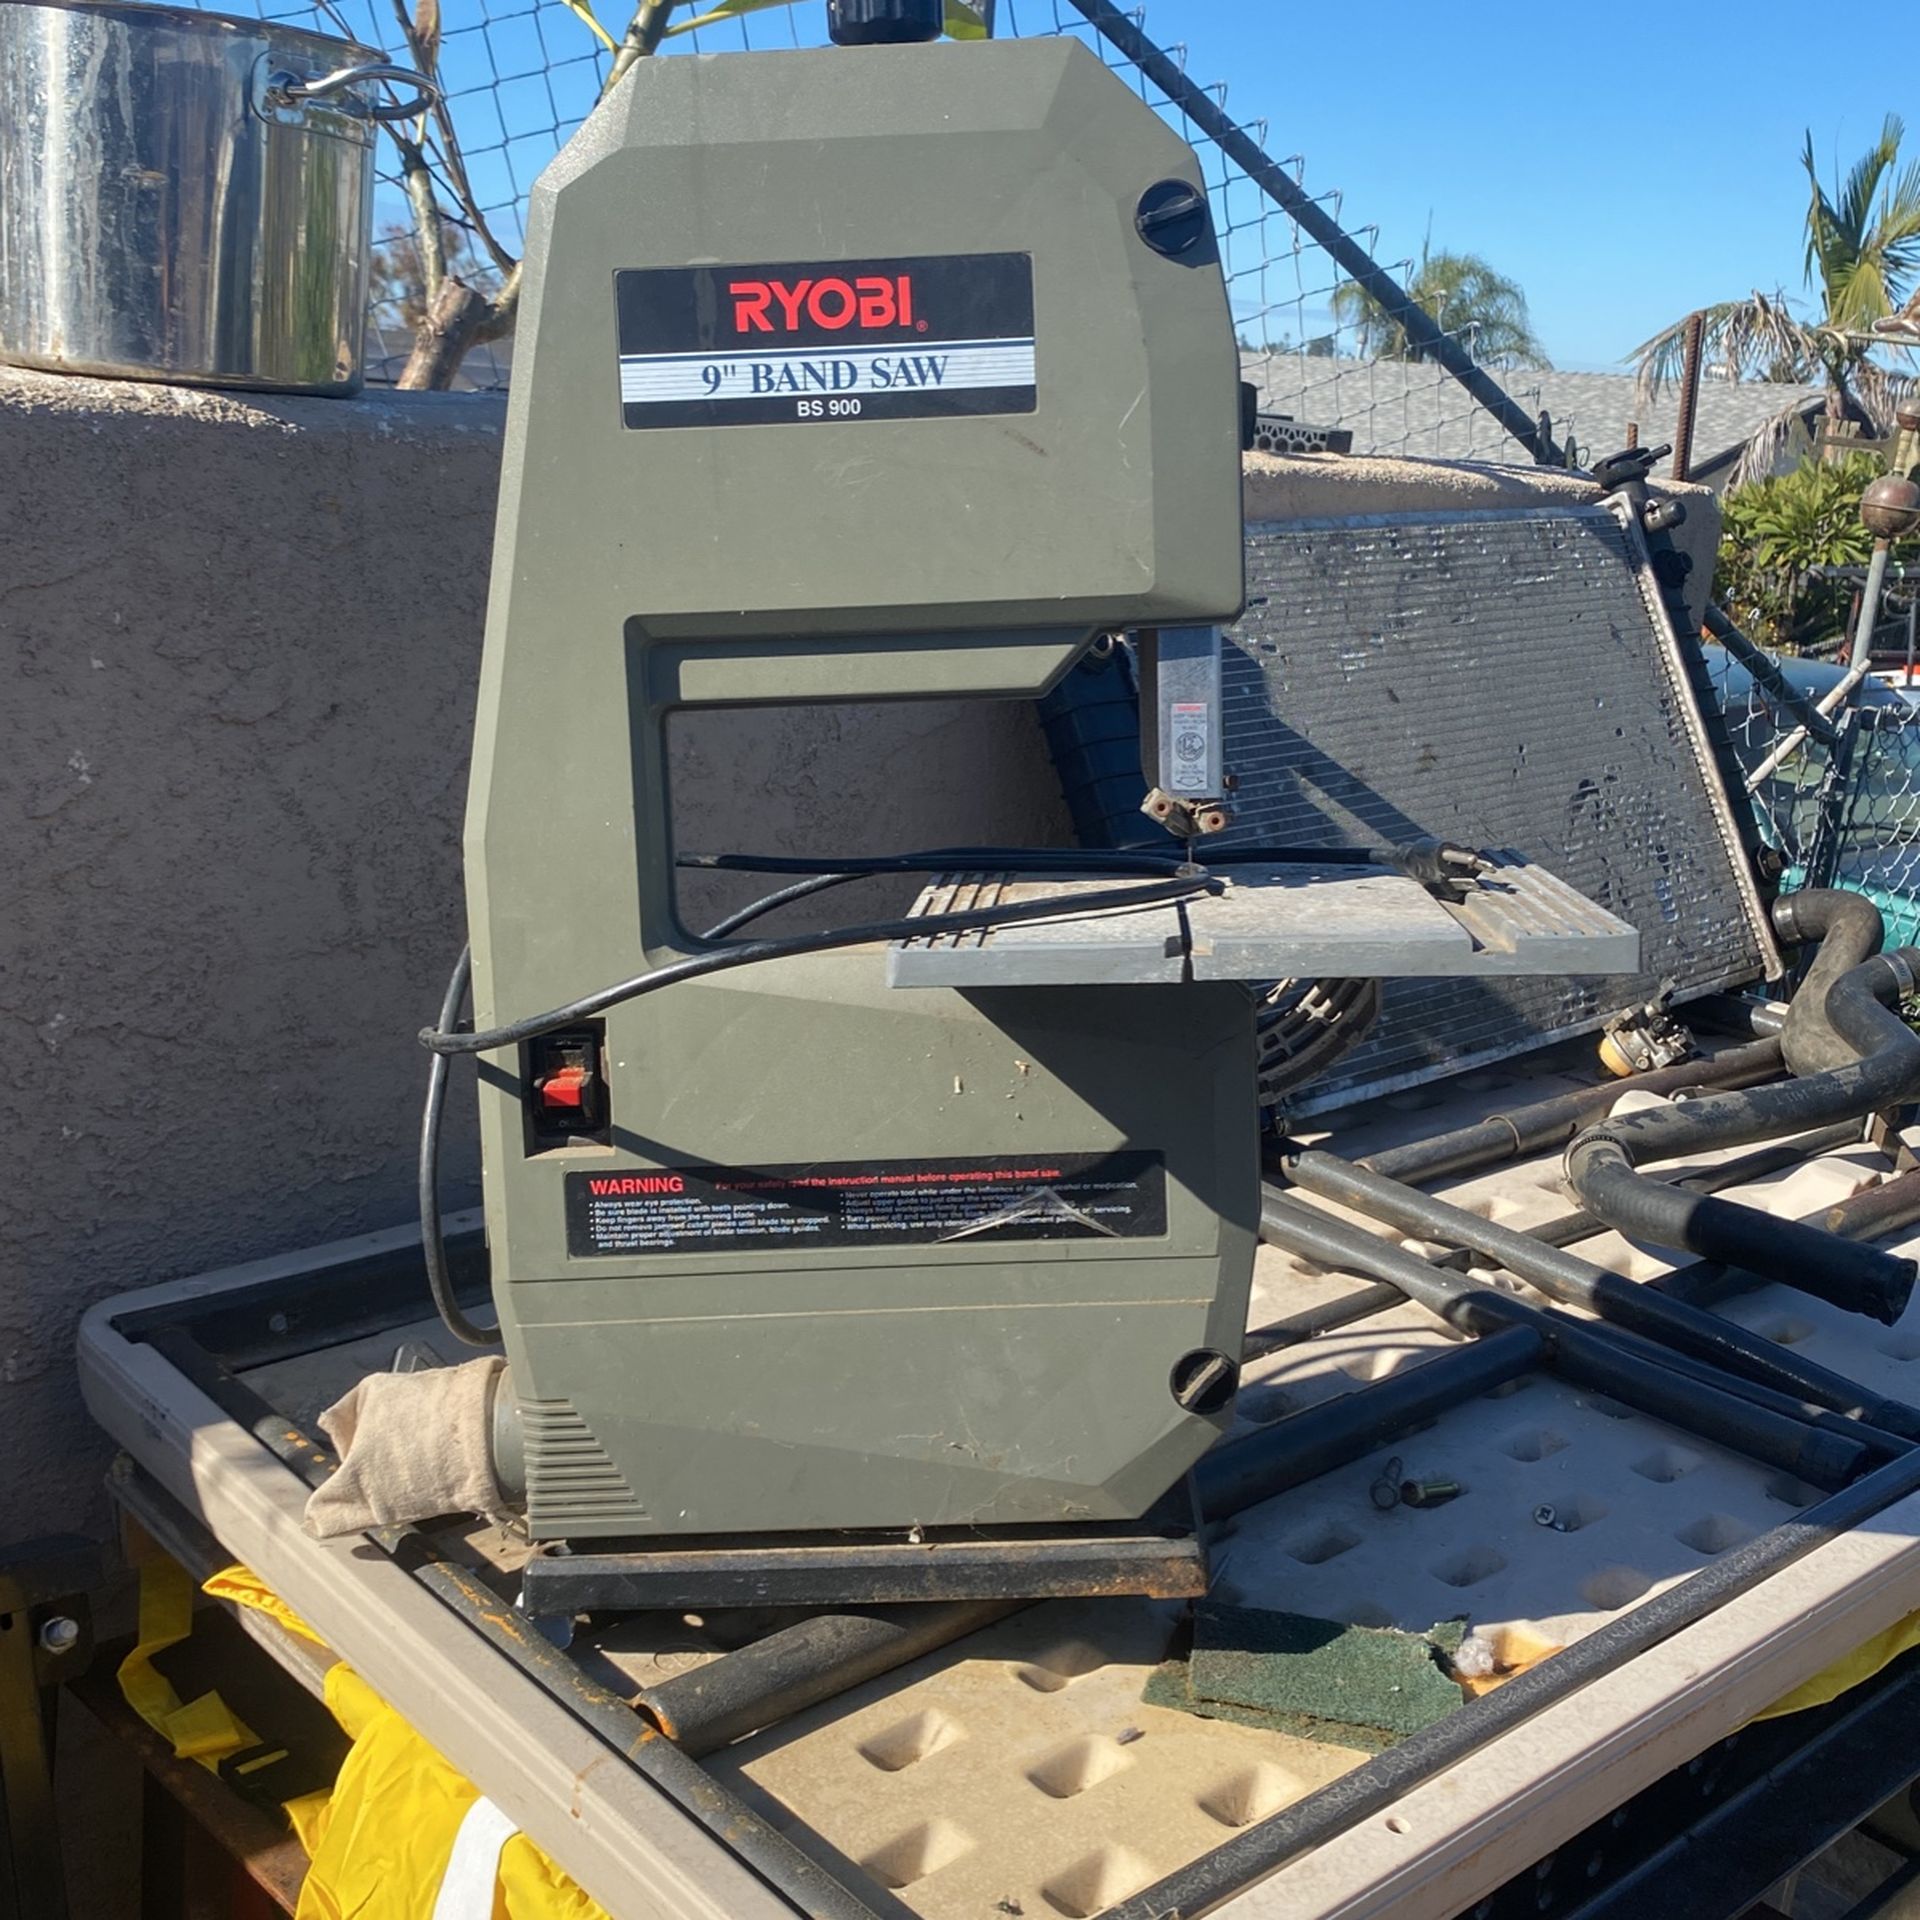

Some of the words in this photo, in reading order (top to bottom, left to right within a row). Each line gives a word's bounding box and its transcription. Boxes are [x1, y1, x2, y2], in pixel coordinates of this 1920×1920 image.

[729, 275, 913, 333] RYOBI
[701, 363, 736, 396] 9"
[749, 359, 858, 395] BAND
[869, 355, 950, 390] SAW
[796, 401, 825, 417] BS
[828, 399, 862, 416] 900
[811, 1177, 826, 1186] the
[827, 1176, 879, 1186] instruction
[880, 1174, 915, 1184] manual
[917, 1172, 947, 1182] before
[948, 1171, 994, 1183] operating
[995, 1170, 1014, 1179] this
[1015, 1169, 1039, 1178] band
[590, 1176, 684, 1196] WARNING
[869, 1190, 900, 1199] operate
[900, 1187, 917, 1196] tool
[917, 1187, 938, 1195] while
[939, 1186, 962, 1195] under
[594, 1200, 623, 1210] Always
[624, 1200, 643, 1208] wear
[644, 1200, 659, 1209] eye
[660, 1198, 702, 1208] protection.
[594, 1208, 606, 1216] Be
[626, 1207, 649, 1215] blade
[650, 1207, 658, 1215] is
[659, 1205, 693, 1214] installed
[694, 1204, 711, 1213] with
[711, 1204, 732, 1213] teeth
[733, 1202, 766, 1213] pointing
[595, 1217, 616, 1226] Keep
[617, 1215, 645, 1225] fingers
[646, 1216, 667, 1225] away
[668, 1214, 687, 1222] from
[688, 1213, 701, 1221] the
[702, 1212, 732, 1222] moving
[595, 1225, 608, 1233] Do
[609, 1224, 622, 1232] not
[623, 1223, 653, 1231] remove
[757, 1218, 779, 1226] blade
[780, 1217, 795, 1225] has
[846, 1222, 870, 1231] When
[909, 1220, 925, 1228] use
[926, 1219, 943, 1229] only
[595, 1232, 630, 1241] Maintain
[631, 1232, 657, 1242] proper
[658, 1229, 702, 1239] adjustment
[703, 1229, 712, 1237] of
[713, 1228, 735, 1236] blade
[769, 1226, 791, 1234] blade
[598, 1240, 613, 1249] and
[614, 1239, 639, 1248] thrust
